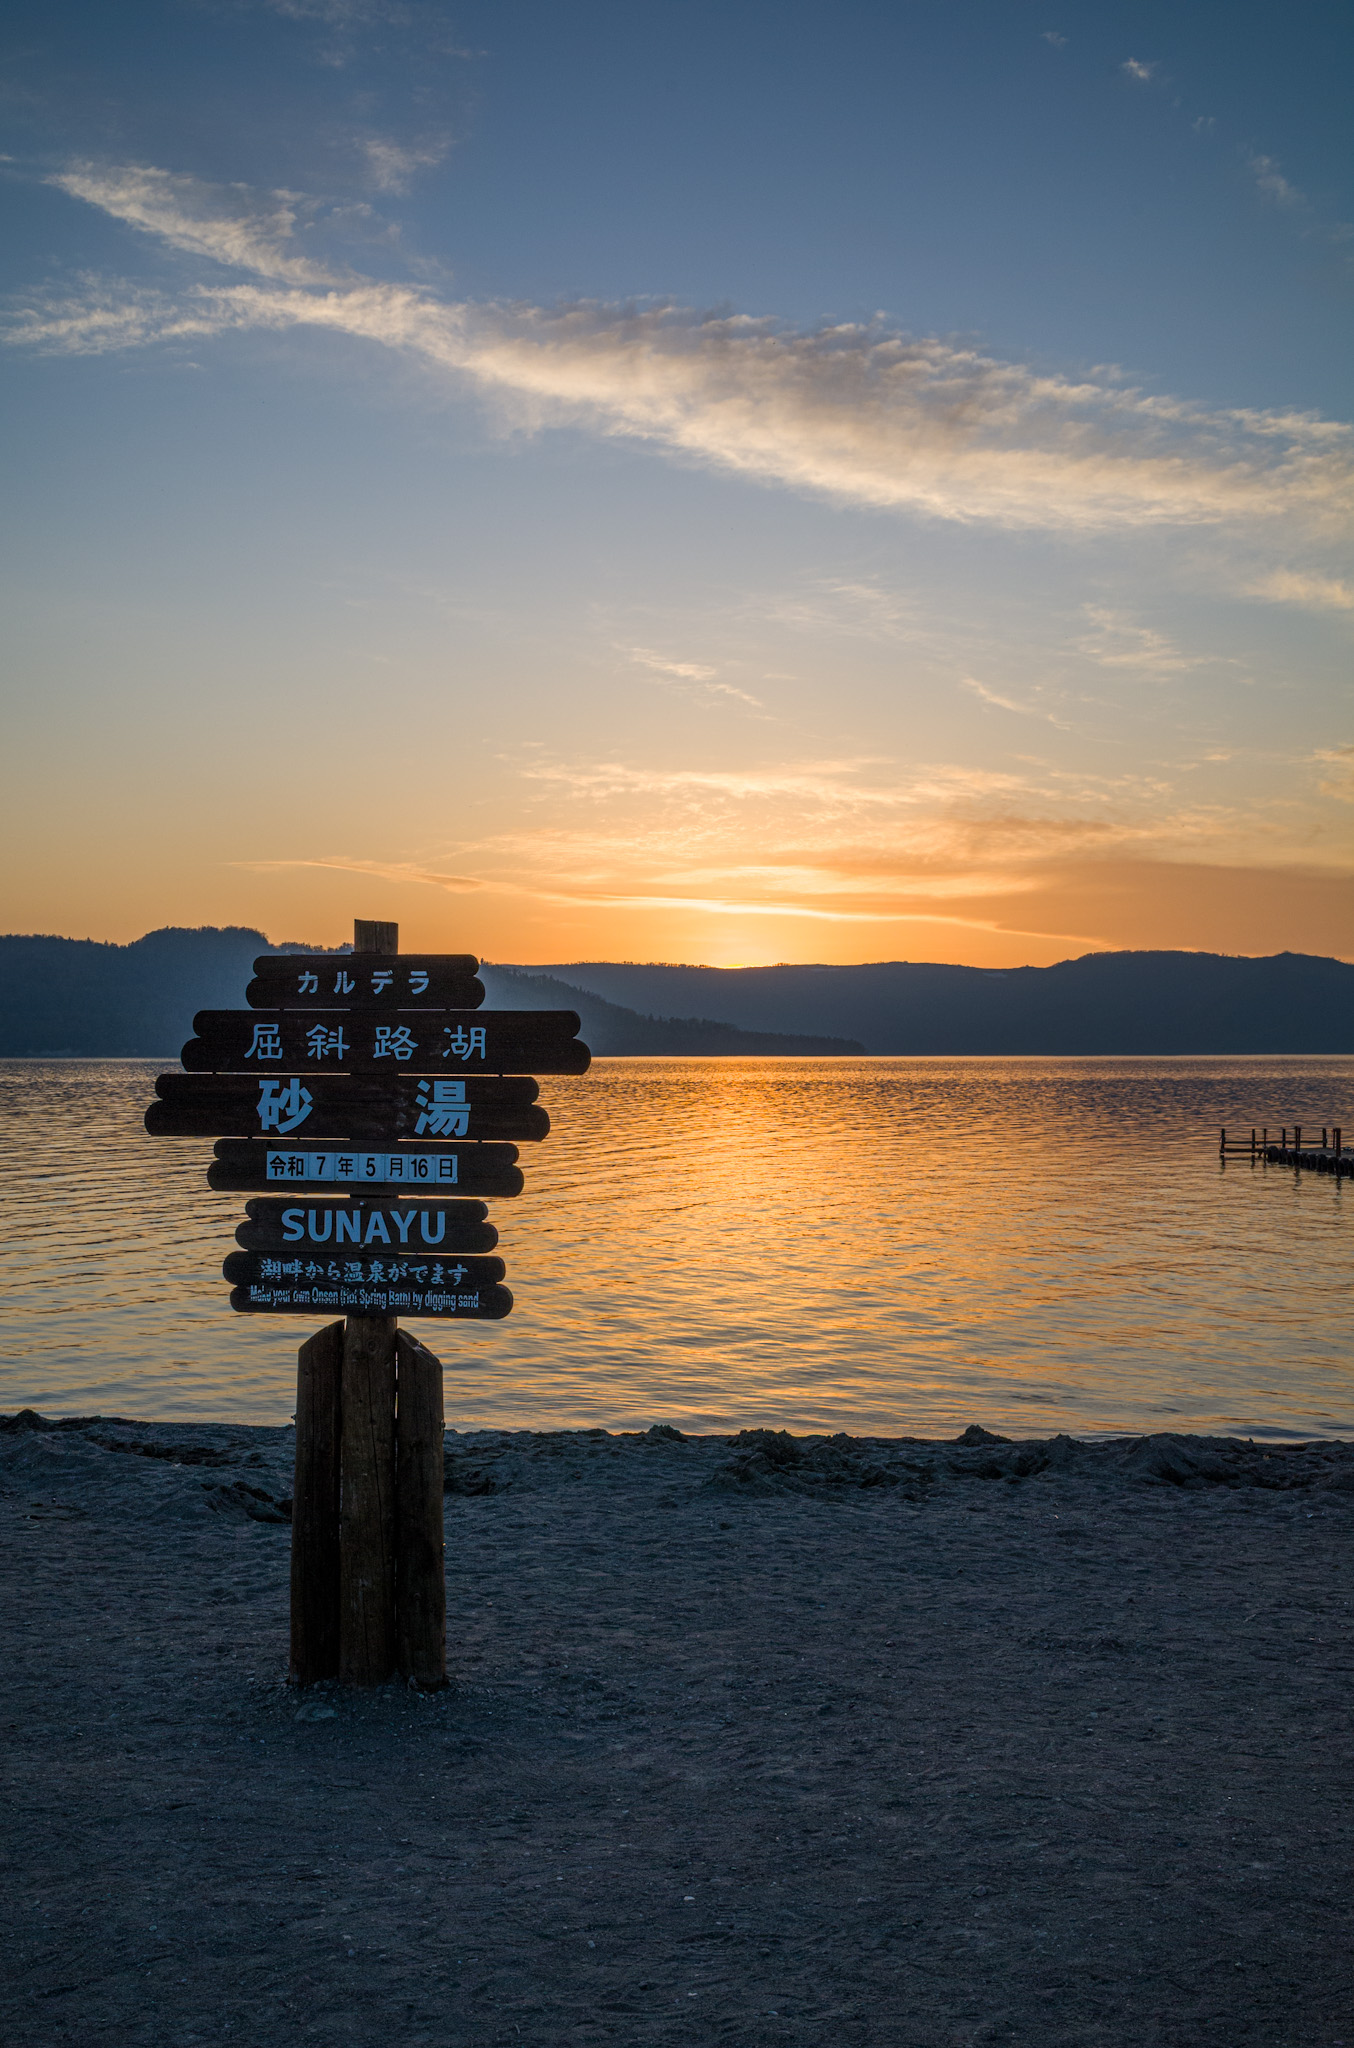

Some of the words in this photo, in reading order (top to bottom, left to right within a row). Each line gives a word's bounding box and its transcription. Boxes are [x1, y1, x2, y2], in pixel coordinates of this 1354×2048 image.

[298, 969, 430, 995] カルデラ
[244, 1023, 487, 1061] 屈斜路湖
[281, 1207, 446, 1244] SUNAYU
[260, 1258, 469, 1286] 湖畔から温泉がでます
[272, 1290, 290, 1306] your
[293, 1290, 310, 1303] own
[312, 1286, 338, 1304] Onsen
[359, 1288, 387, 1309] Spring
[412, 1291, 423, 1310] by
[424, 1290, 456, 1311] digging
[458, 1291, 479, 1308] sand
